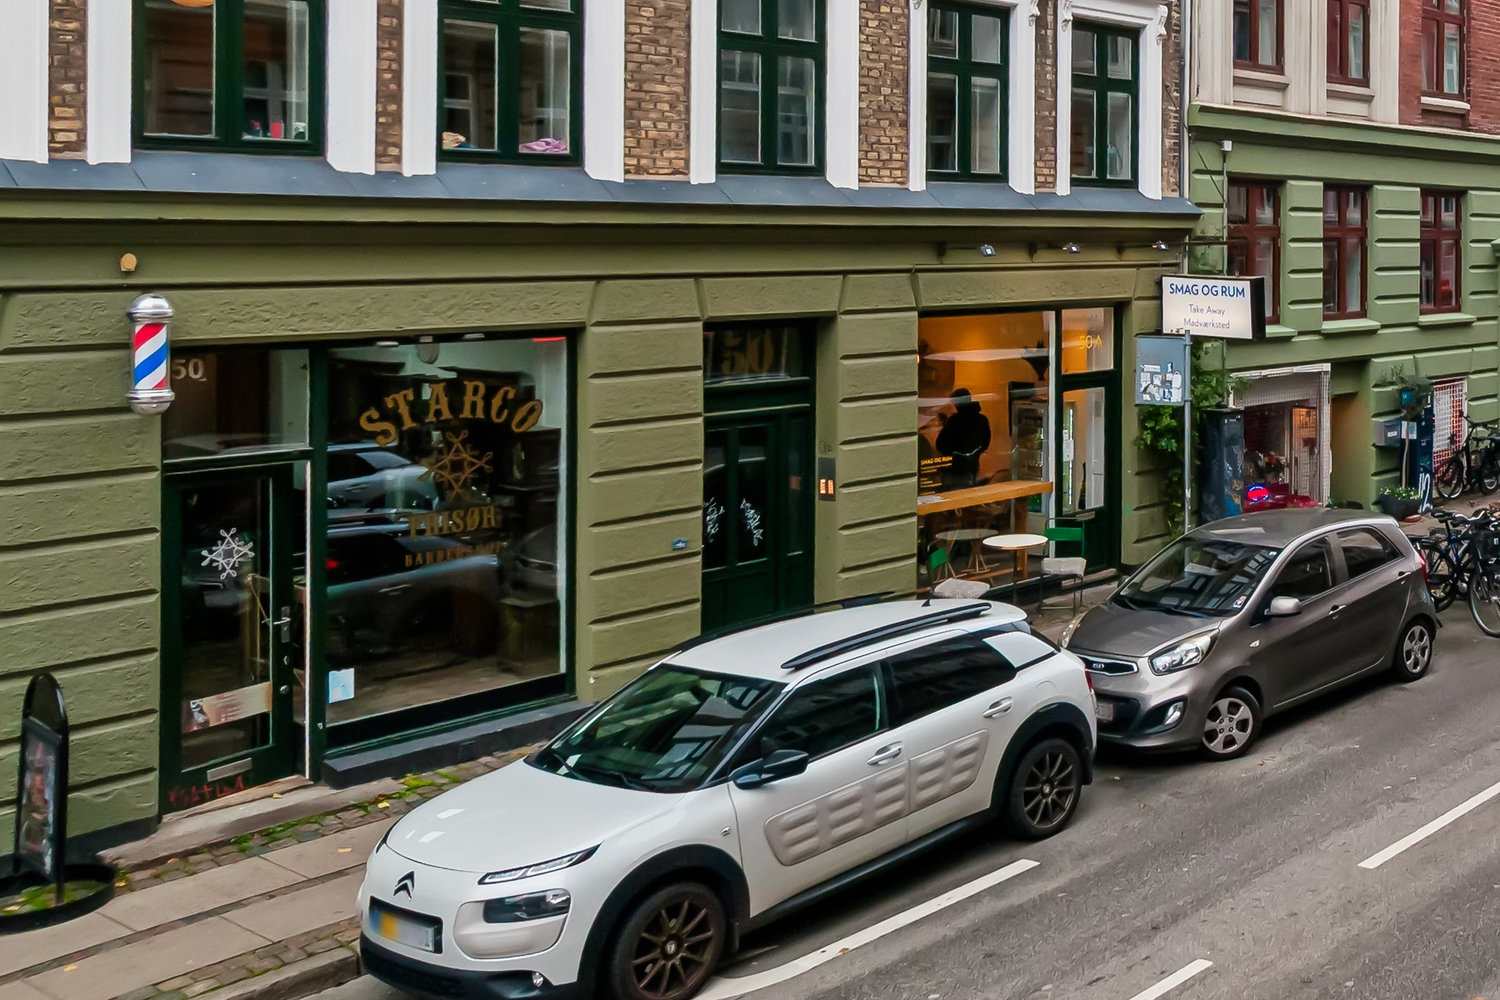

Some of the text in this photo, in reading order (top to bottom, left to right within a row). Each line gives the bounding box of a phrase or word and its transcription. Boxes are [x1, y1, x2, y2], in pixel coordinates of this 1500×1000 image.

[1169, 283, 1245, 298] SMAG OG RUM
[1188, 304, 1226, 317] Take Away
[1183, 318, 1230, 330] Madværksted
[721, 335, 775, 376] 50
[359, 380, 543, 448] STARCO
